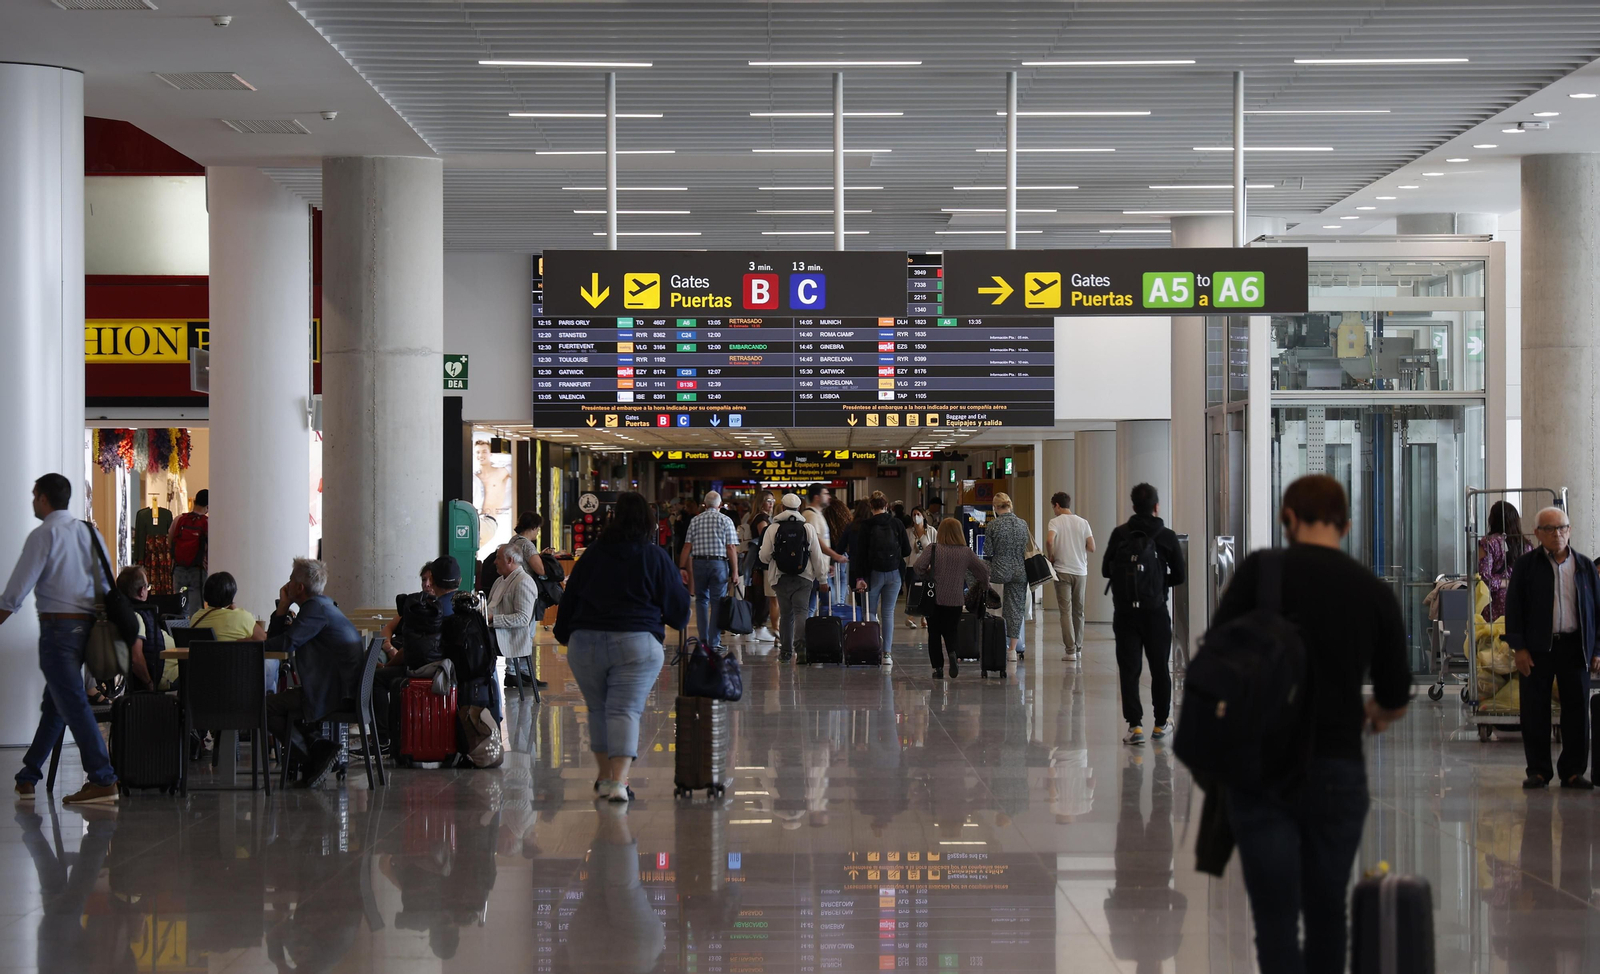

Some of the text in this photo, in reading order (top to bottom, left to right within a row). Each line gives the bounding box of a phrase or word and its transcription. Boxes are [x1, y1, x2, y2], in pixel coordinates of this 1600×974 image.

[748, 262, 756, 271] 3
[792, 262, 805, 271] 13
[670, 274, 710, 288] Gates
[1071, 274, 1211, 287] Gates to
[670, 278, 818, 308] Puertas B C
[1071, 277, 1259, 306] Puertas A5 a A6
[448, 380, 463, 388] DEA
[660, 417, 667, 425] B
[680, 416, 687, 425] C
